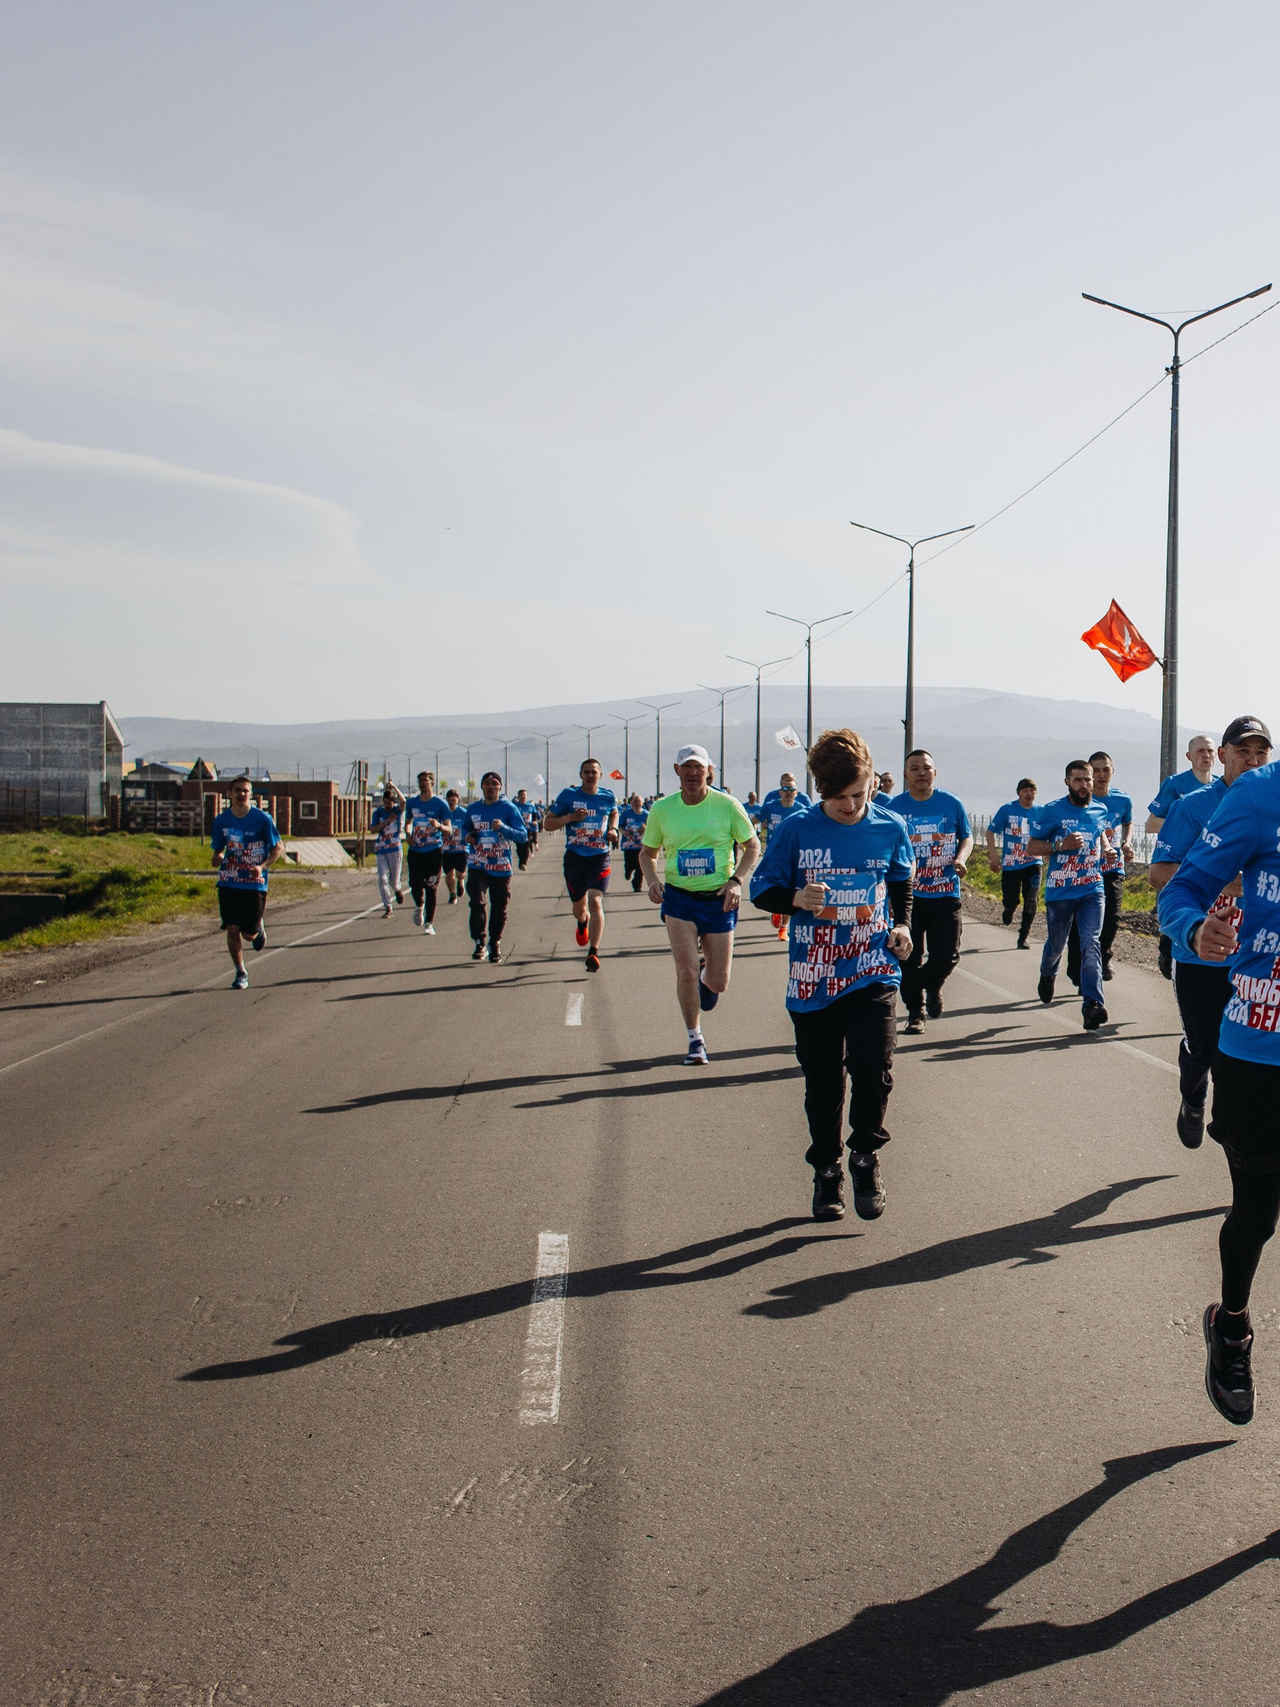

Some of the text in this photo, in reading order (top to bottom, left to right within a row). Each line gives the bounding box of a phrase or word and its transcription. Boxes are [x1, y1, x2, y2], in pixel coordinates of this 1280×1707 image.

[685, 858, 709, 867] 40001
[798, 848, 832, 868] 2024
[829, 889, 867, 905] 20002
[837, 907, 856, 919] 5КМ
[795, 925, 837, 944] #ЗАБЕГ
[857, 948, 887, 974] 2024
